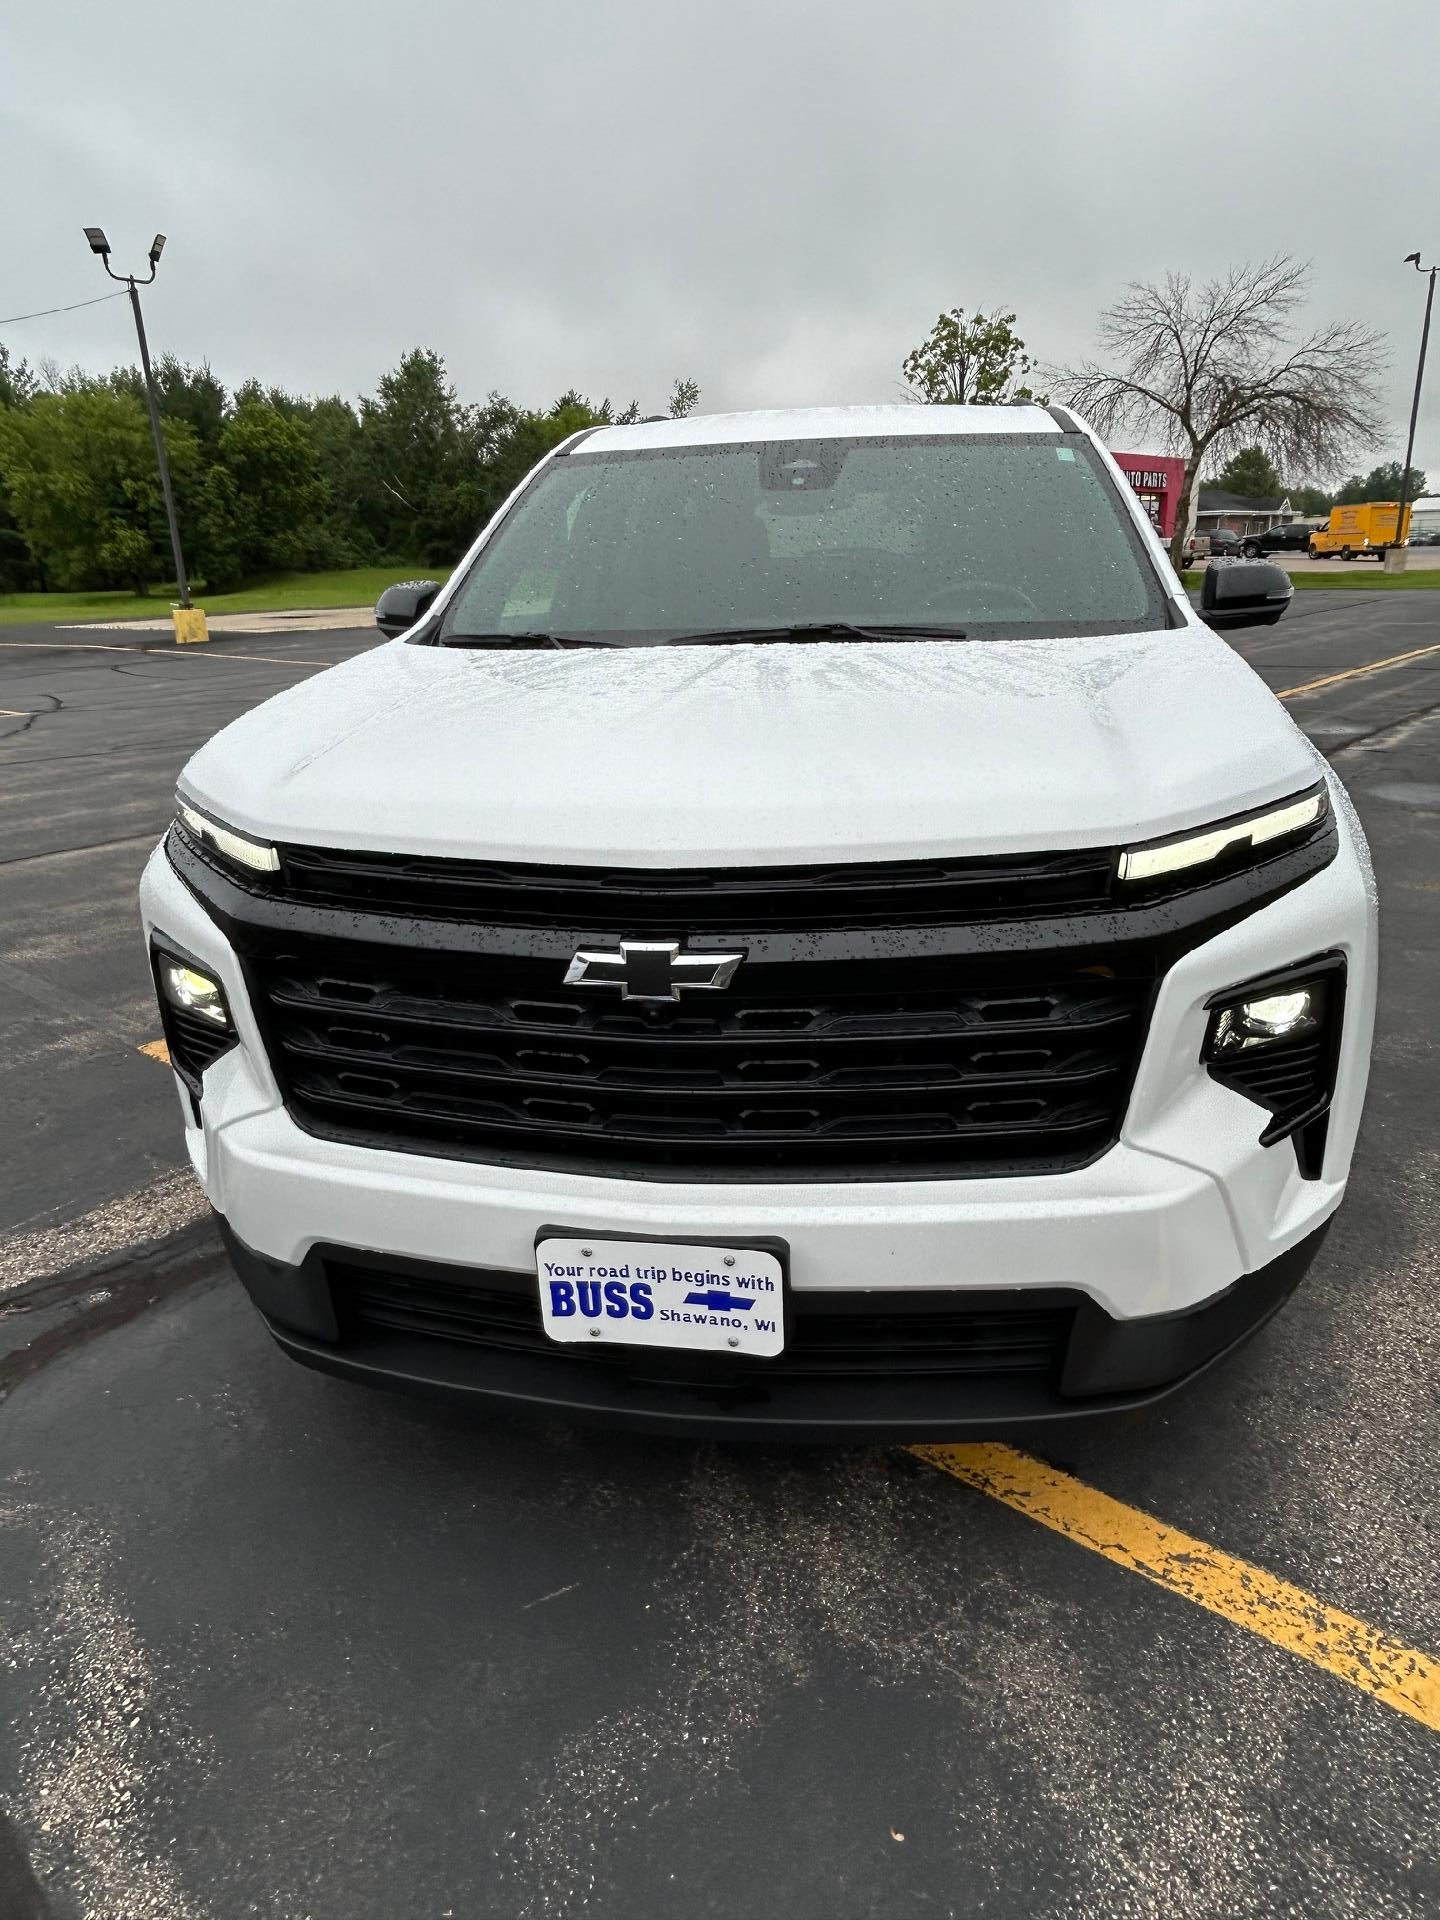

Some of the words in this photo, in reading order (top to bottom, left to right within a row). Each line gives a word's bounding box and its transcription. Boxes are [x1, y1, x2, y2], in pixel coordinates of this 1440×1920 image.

[1124, 471, 1141, 487] UTO
[1143, 471, 1167, 488] PARTS
[544, 1262, 584, 1277] Your
[589, 1265, 630, 1278] road
[636, 1267, 667, 1283] trip
[672, 1267, 731, 1287] begins
[736, 1275, 775, 1292] with
[550, 1280, 655, 1321] BUSS
[660, 1309, 748, 1331] Shawano,
[755, 1318, 776, 1333] WI
